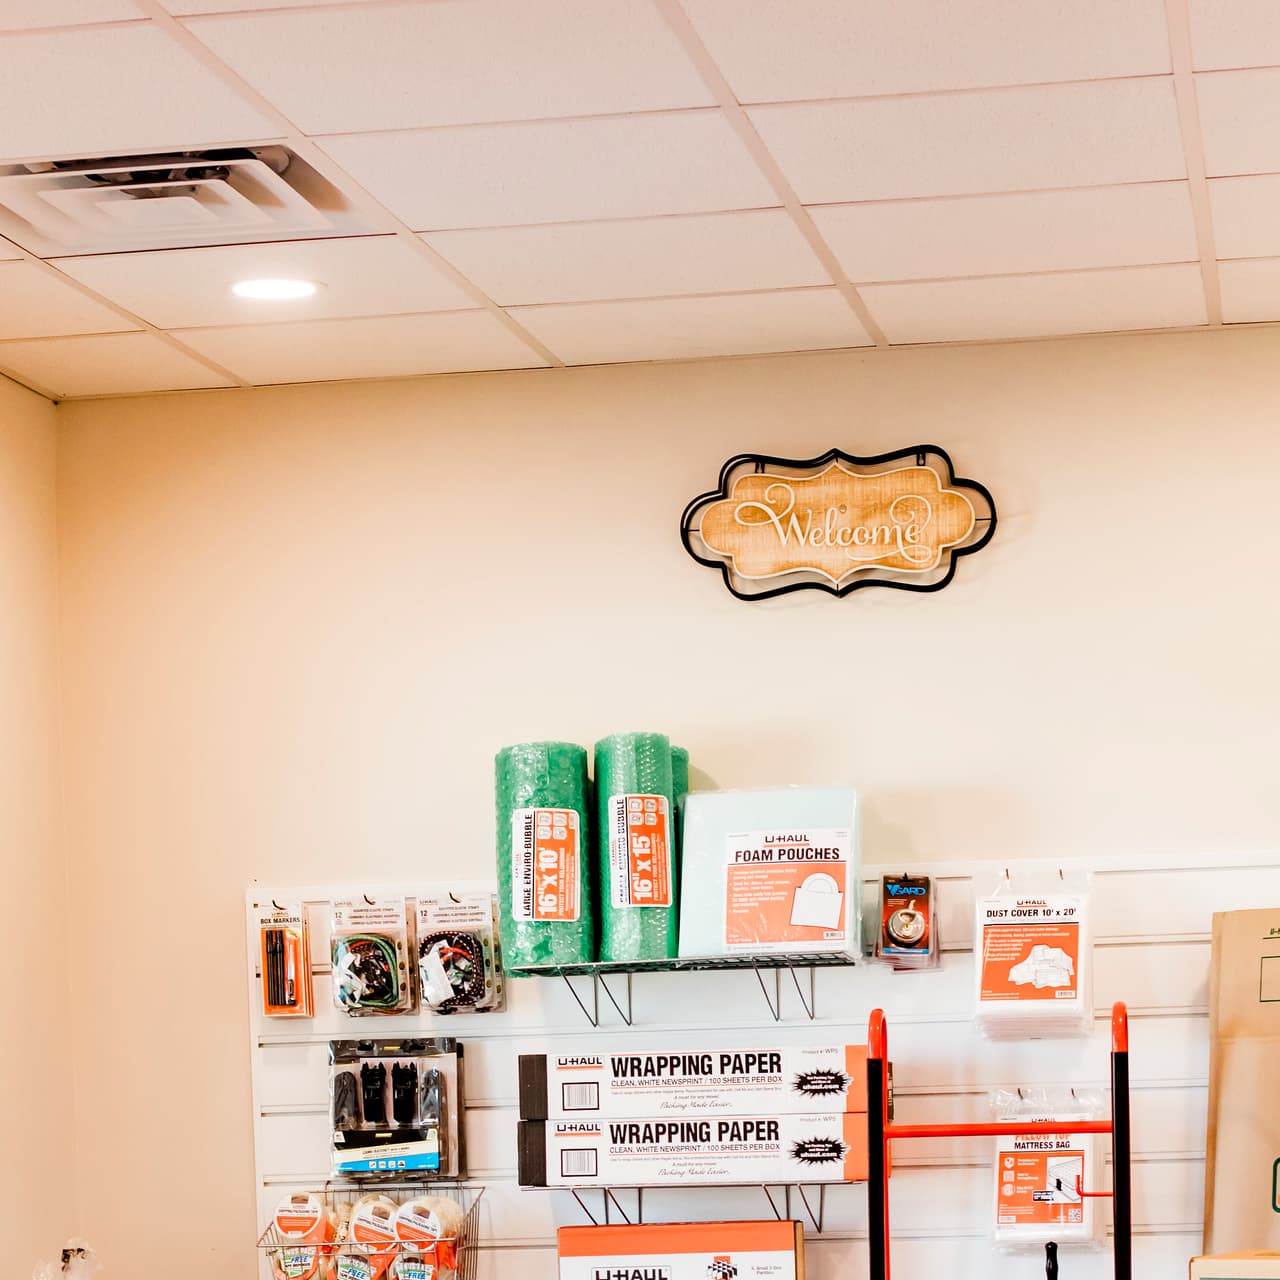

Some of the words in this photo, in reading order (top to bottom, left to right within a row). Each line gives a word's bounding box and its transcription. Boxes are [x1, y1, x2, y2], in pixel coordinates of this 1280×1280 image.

[734, 483, 932, 562] Welcome
[765, 834, 810, 843] U-HAUL
[735, 849, 773, 862] FOAM
[778, 848, 840, 860] POUCHES
[523, 884, 532, 916] LARGE
[986, 909, 1008, 918] DUST
[1011, 909, 1039, 917] COVER
[557, 1057, 602, 1067] U-HAUL
[610, 1054, 713, 1078] WRAPPING
[719, 1052, 782, 1075] PAPER
[767, 1075, 782, 1083] BOX
[556, 1123, 601, 1132] U-HAUL
[609, 1122, 711, 1145] WRAPPING
[717, 1120, 779, 1142] PAPER
[348, 1269, 366, 1280] FREE
